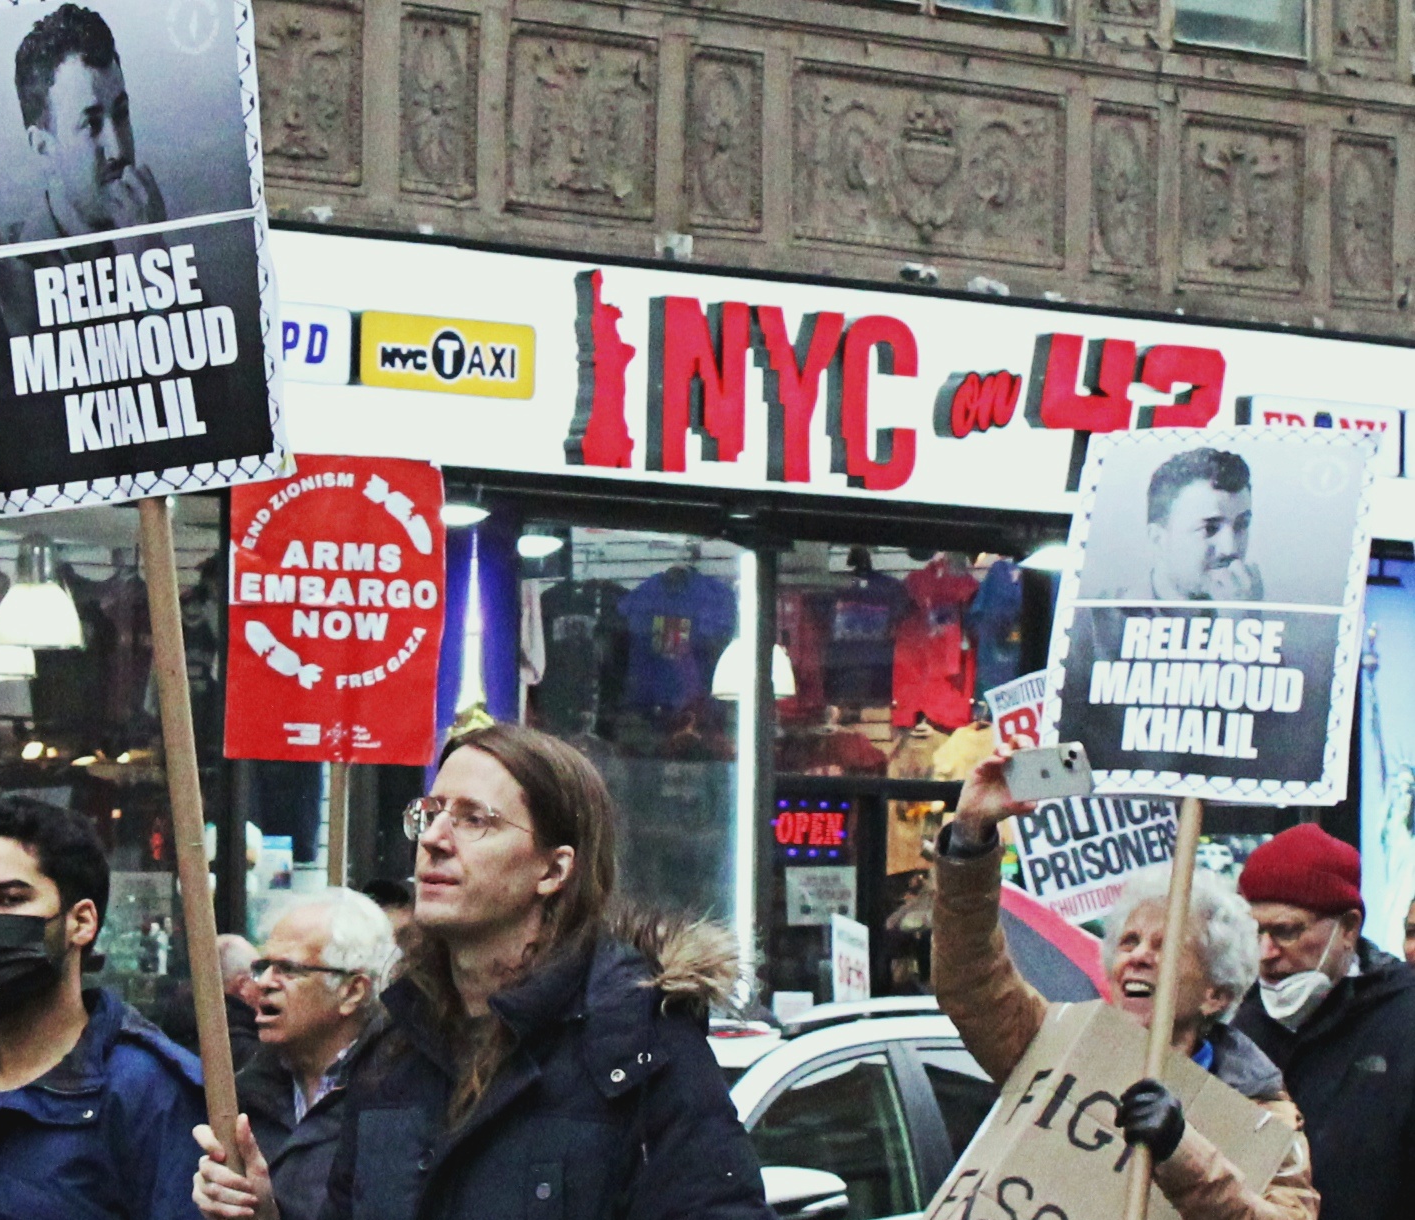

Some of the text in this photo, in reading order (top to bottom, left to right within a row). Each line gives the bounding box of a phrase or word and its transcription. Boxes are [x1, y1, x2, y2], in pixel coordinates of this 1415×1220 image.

[34, 244, 203, 327] RELEASE
[10, 305, 238, 396] MAHMOUD
[431, 330, 516, 379] TAXI
[65, 377, 207, 453] KHALIL
[648, 296, 919, 491] NYC
[935, 369, 1021, 438] on
[241, 472, 355, 549] END ZIONISM
[280, 540, 402, 573] ARMS
[240, 572, 438, 609] EMBARGO
[292, 610, 389, 641] NOW
[1120, 617, 1285, 664] RELEASE
[336, 626, 427, 690] FREE GAZA
[1089, 660, 1304, 713] MAHMOUD
[1121, 706, 1259, 759] KHALIL
[775, 812, 845, 845] OPEN
[1005, 1069, 1135, 1174] FIG
